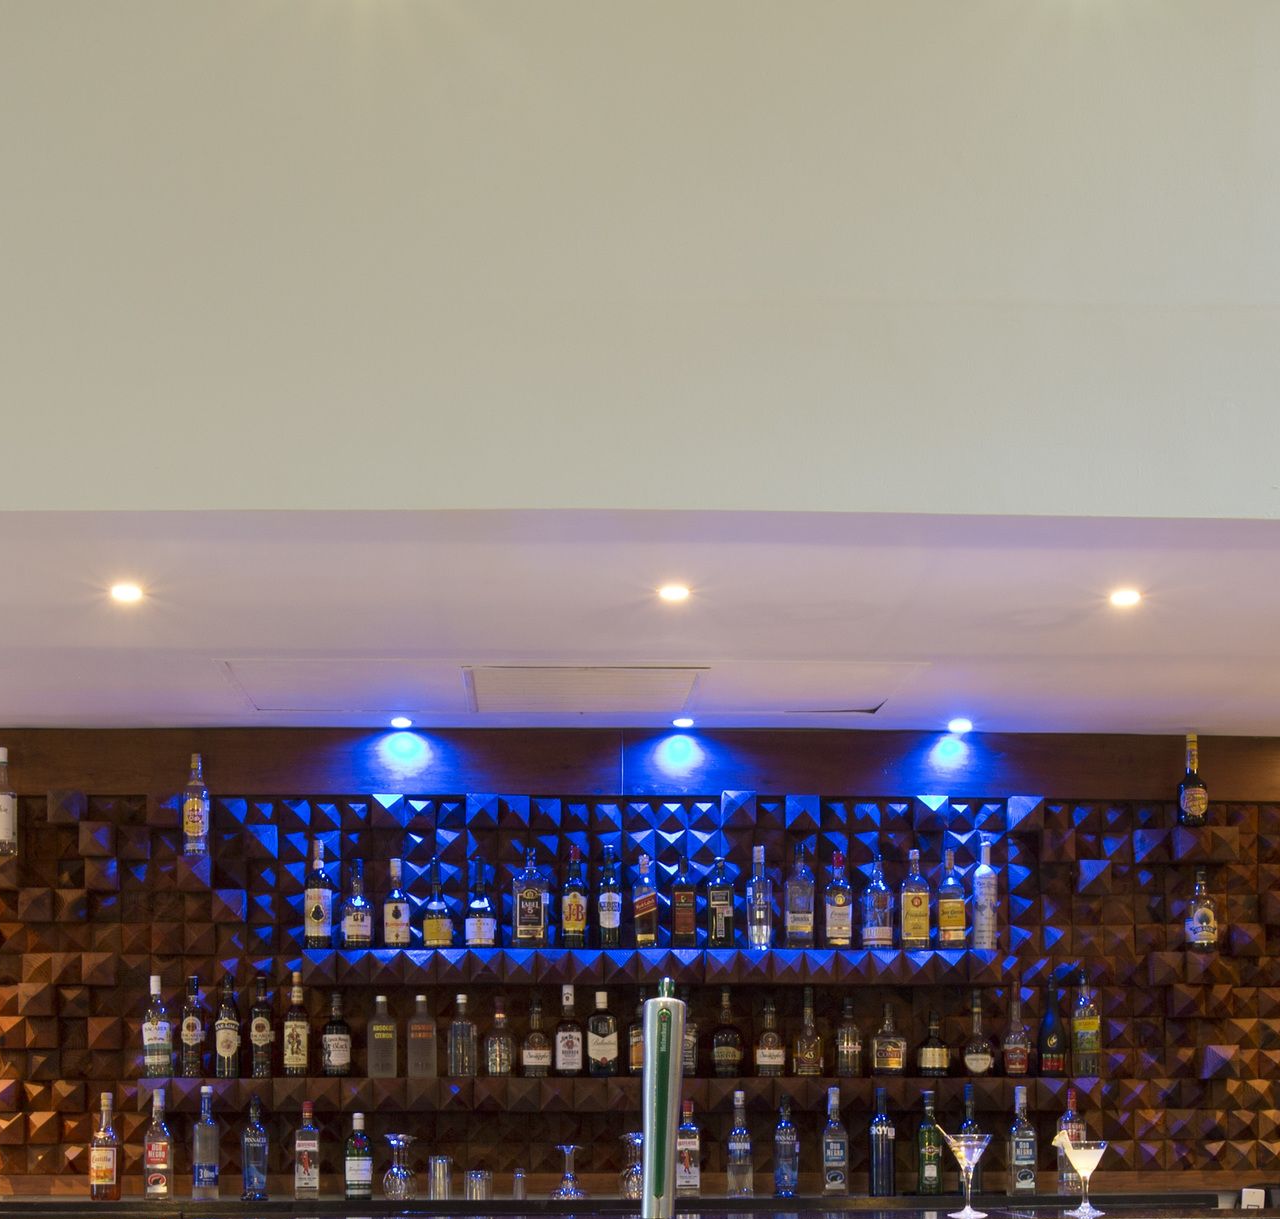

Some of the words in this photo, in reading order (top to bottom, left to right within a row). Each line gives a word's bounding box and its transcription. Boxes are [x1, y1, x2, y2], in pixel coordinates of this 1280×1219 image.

[521, 901, 540, 909] LABEL
[659, 1022, 667, 1052] Heineken
[804, 1051, 815, 1059] 43
